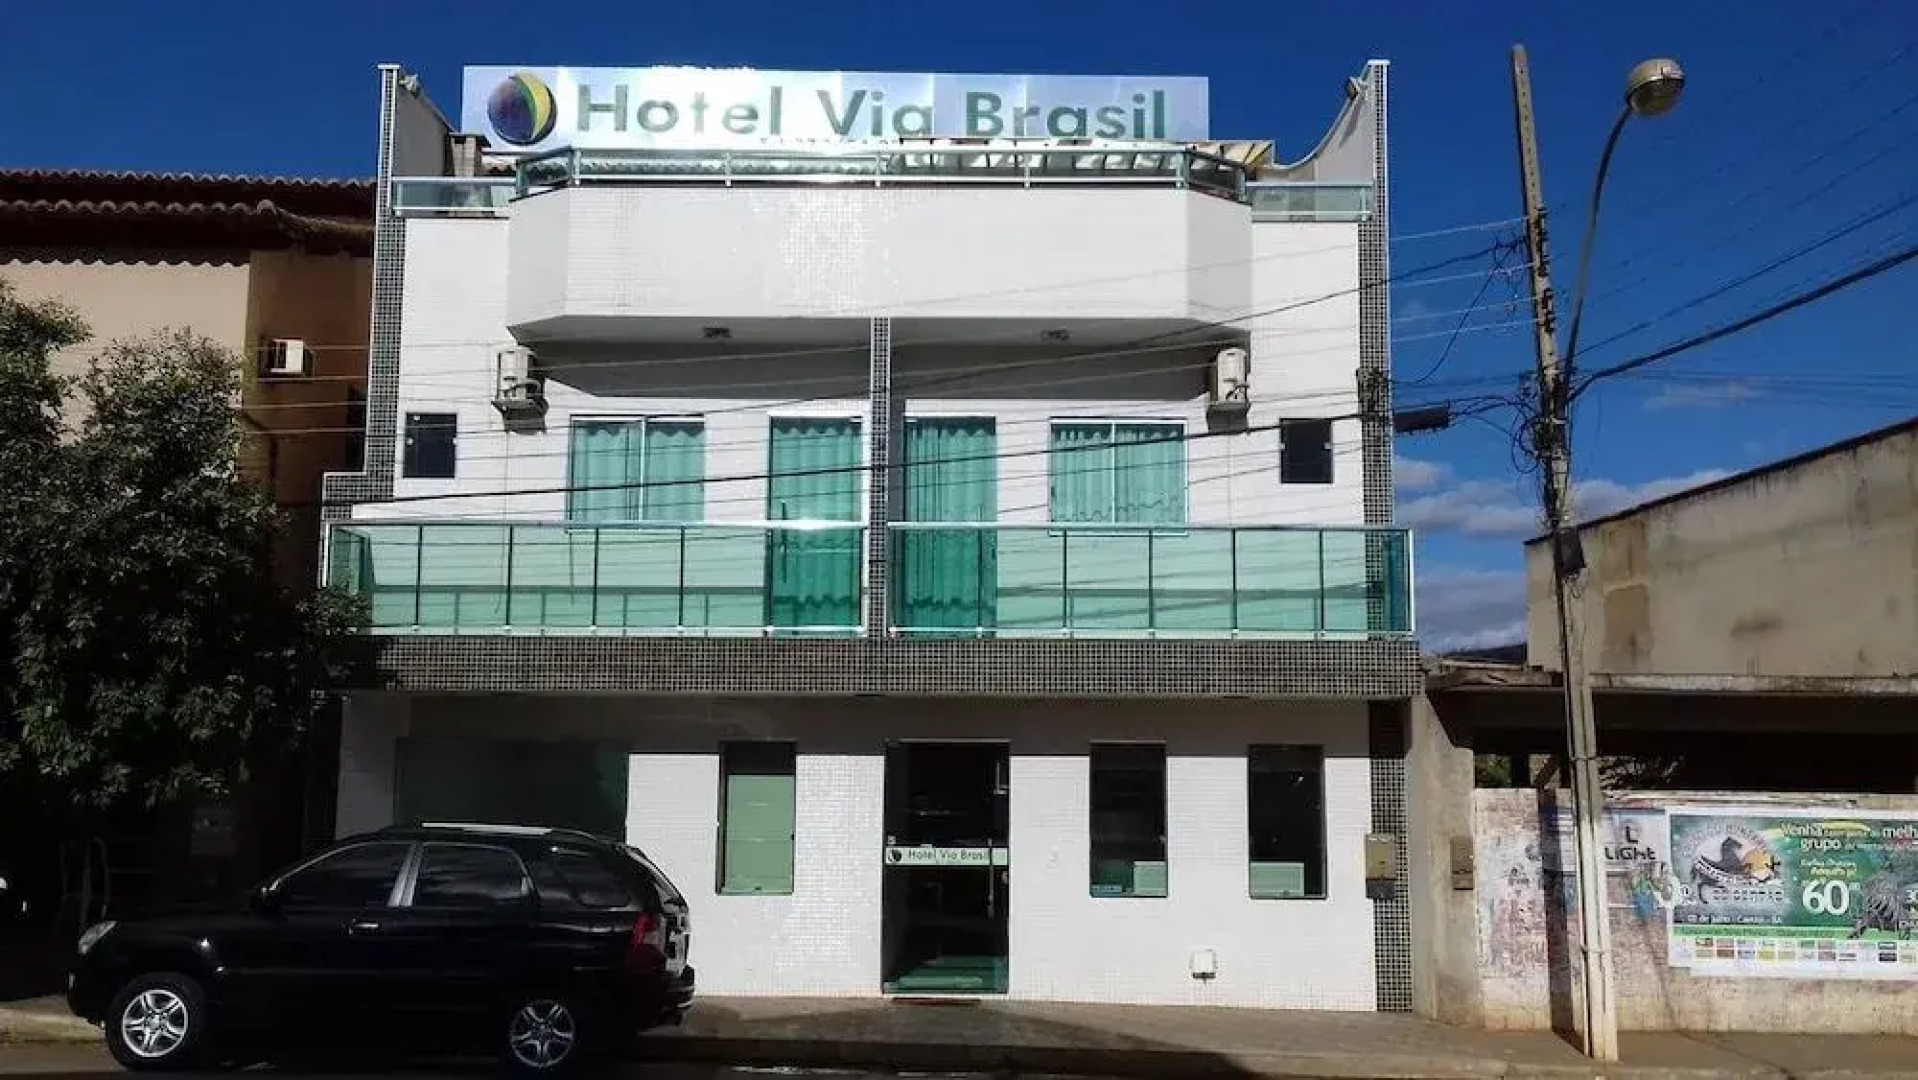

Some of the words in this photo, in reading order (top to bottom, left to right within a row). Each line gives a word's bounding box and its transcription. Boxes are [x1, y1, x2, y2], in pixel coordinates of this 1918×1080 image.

[577, 83, 782, 135] Hotel
[816, 89, 932, 137] Via
[965, 88, 1165, 139] Brasil
[908, 849, 936, 860] Hotel
[939, 849, 958, 860] Via
[1800, 838, 1841, 853] grupo
[1802, 880, 1849, 916] 60
